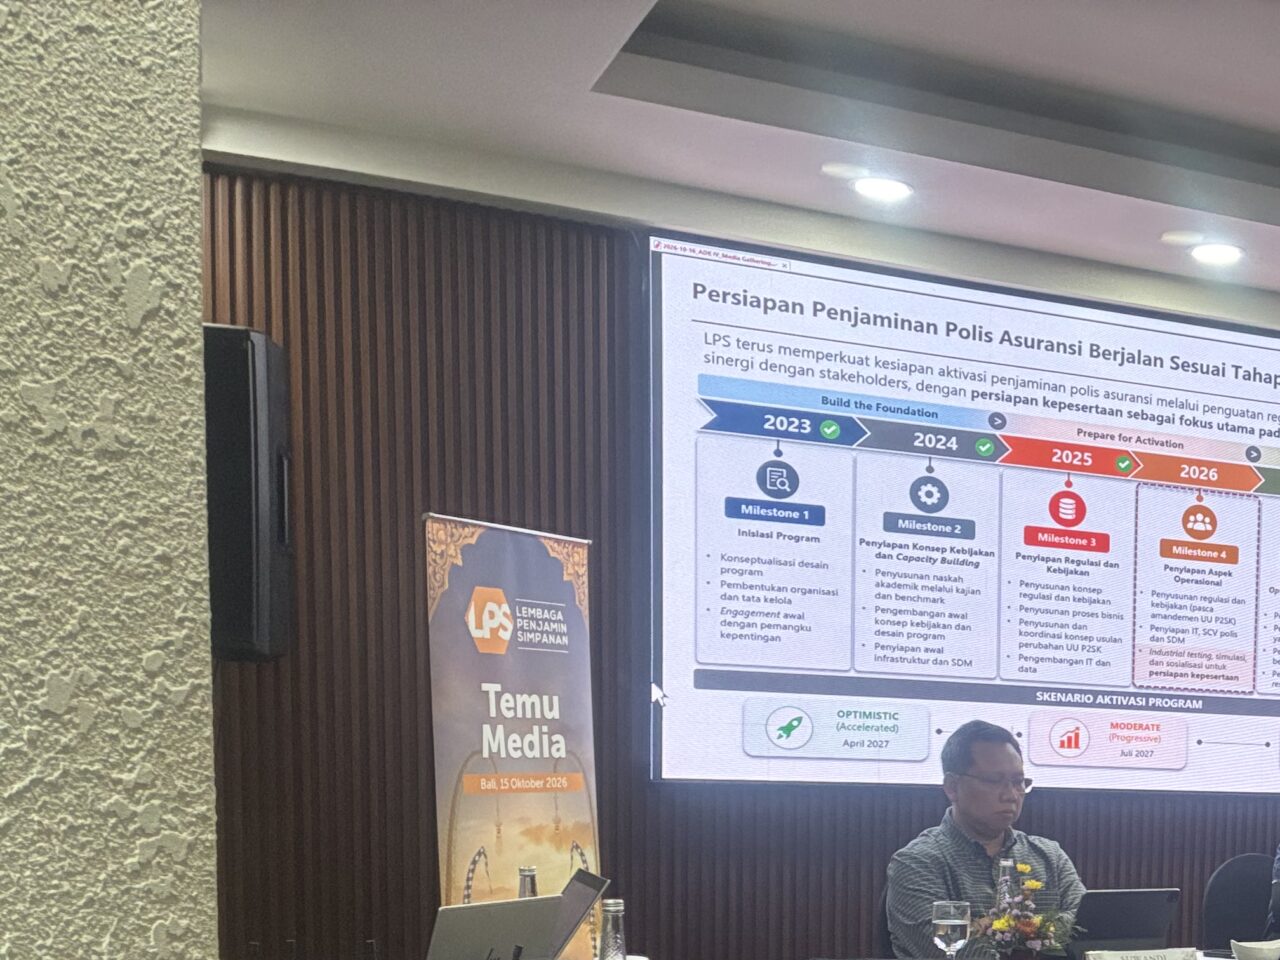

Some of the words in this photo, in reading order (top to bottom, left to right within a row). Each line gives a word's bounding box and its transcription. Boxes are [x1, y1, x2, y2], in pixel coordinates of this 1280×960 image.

[692, 282, 806, 316] Persiapan
[811, 300, 939, 335] Penjaminan
[943, 320, 994, 343] Polis
[998, 328, 1083, 356] Asuransi
[1087, 342, 1165, 368] Berjalan
[1168, 354, 1230, 378] Sesuai
[703, 332, 732, 348] LPS
[735, 338, 774, 353] terus
[776, 345, 871, 366] memperkuat
[873, 356, 934, 376] kesiapan
[936, 366, 987, 382] aktivasi
[989, 374, 1067, 393] penjaminan
[1068, 385, 1100, 398] polis
[1102, 390, 1153, 405] asuransi
[1155, 397, 1200, 411] melalui
[1201, 404, 1264, 420] penguatan
[703, 351, 755, 372] sinergi
[758, 358, 815, 378] dengan
[818, 368, 912, 391] stakeholders,
[914, 379, 968, 398] dengan
[970, 389, 1039, 407] persiapan
[1041, 396, 1124, 418] kepesertaan
[1126, 409, 1176, 426] sebagai
[1177, 414, 1214, 429] fokus
[1215, 421, 1256, 435] utama
[821, 395, 851, 408] Build
[853, 400, 873, 411] the
[875, 402, 938, 419] Foundation
[763, 414, 811, 434] 2023
[913, 432, 958, 451] 2024
[1076, 428, 1116, 441] Prepare
[1117, 433, 1133, 443] for
[1134, 435, 1183, 450] Activation
[1051, 448, 1092, 466] 2025
[1179, 464, 1218, 481] 2026
[741, 504, 800, 519] Milestone
[802, 510, 809, 520] 1
[897, 519, 952, 533] Milestone
[954, 524, 961, 534] 2
[737, 528, 774, 539] Inisiasi
[775, 531, 820, 544] Program
[1037, 532, 1088, 546] Milestone
[1089, 537, 1096, 546] 3
[858, 537, 910, 551] Penyiapan
[911, 542, 947, 555] Konsep
[948, 545, 995, 557] Kebijakan
[1172, 545, 1218, 558] Milestone
[1220, 550, 1226, 558] 4
[720, 552, 796, 567] Konseptualisasi
[797, 559, 829, 569] desain
[875, 550, 894, 560] dan
[895, 552, 938, 566] Capacity
[939, 556, 980, 569] Building
[1015, 552, 1062, 564] Penyiapan
[1063, 556, 1101, 567] Regulasi
[1102, 560, 1119, 568] dan
[720, 567, 763, 577] program
[875, 568, 931, 580] Penyusunan
[932, 574, 963, 583] naskah
[1046, 565, 1089, 576] Kebijakan
[1163, 564, 1206, 576] Penyiapan
[1207, 568, 1232, 578] Aspek
[720, 580, 788, 593] Pembentukan
[789, 587, 838, 596] organisasi
[874, 580, 919, 590] akademik
[920, 584, 954, 593] melalui
[955, 586, 981, 596] kajian
[1019, 580, 1070, 591] Penyusunan
[1071, 584, 1102, 595] konsep
[1173, 575, 1222, 586] Operasional
[720, 592, 740, 601] dan
[741, 594, 761, 603] tata
[762, 595, 792, 605] kelola
[874, 591, 893, 600] dan
[894, 593, 945, 604] benchmark
[1019, 592, 1052, 601] regulasi
[1053, 593, 1070, 602] dan
[1071, 595, 1111, 605] kebijakan
[516, 606, 563, 621] LEMBAGA
[720, 606, 781, 618] Engagement
[782, 612, 804, 620] awal
[874, 605, 946, 619] Pengembangan
[947, 611, 968, 619] awal
[1018, 605, 1070, 616] Penyusunan
[1071, 610, 1099, 618] proses
[1100, 611, 1124, 620] bisnis
[468, 601, 513, 640] LPS
[517, 619, 567, 633] PENJAMIN
[720, 618, 758, 630] dengan
[759, 623, 811, 634] pemangku
[874, 617, 908, 629] konsep
[909, 619, 953, 630] kebijakan
[953, 622, 971, 631] dan
[518, 631, 568, 645] SIMPANAN
[720, 630, 781, 643] kepentingan
[874, 628, 904, 638] desain
[905, 632, 945, 641] program
[874, 642, 922, 654] Penyiapan
[923, 646, 943, 654] awal
[874, 654, 930, 664] infrastruktur
[931, 657, 949, 665] dan
[950, 658, 972, 667] SDM
[481, 683, 560, 719] Temu
[1035, 691, 1094, 703] SKENARIO
[1095, 694, 1146, 706] AKTIVASI
[1147, 696, 1202, 709] PROGRAM
[836, 709, 898, 720] OPTIMISTIC
[836, 721, 898, 733] (Accelerated)
[1109, 721, 1160, 731] MODERATE
[482, 724, 566, 759] Media
[842, 738, 865, 749] April
[866, 739, 889, 748] 2027
[1108, 732, 1161, 743] (Progressive)
[1119, 748, 1133, 757] Juli
[1134, 749, 1153, 757] 2027
[480, 778, 498, 790] Bali,
[500, 778, 509, 788] 15
[510, 778, 544, 788] Oktober
[546, 777, 568, 788] 2026
